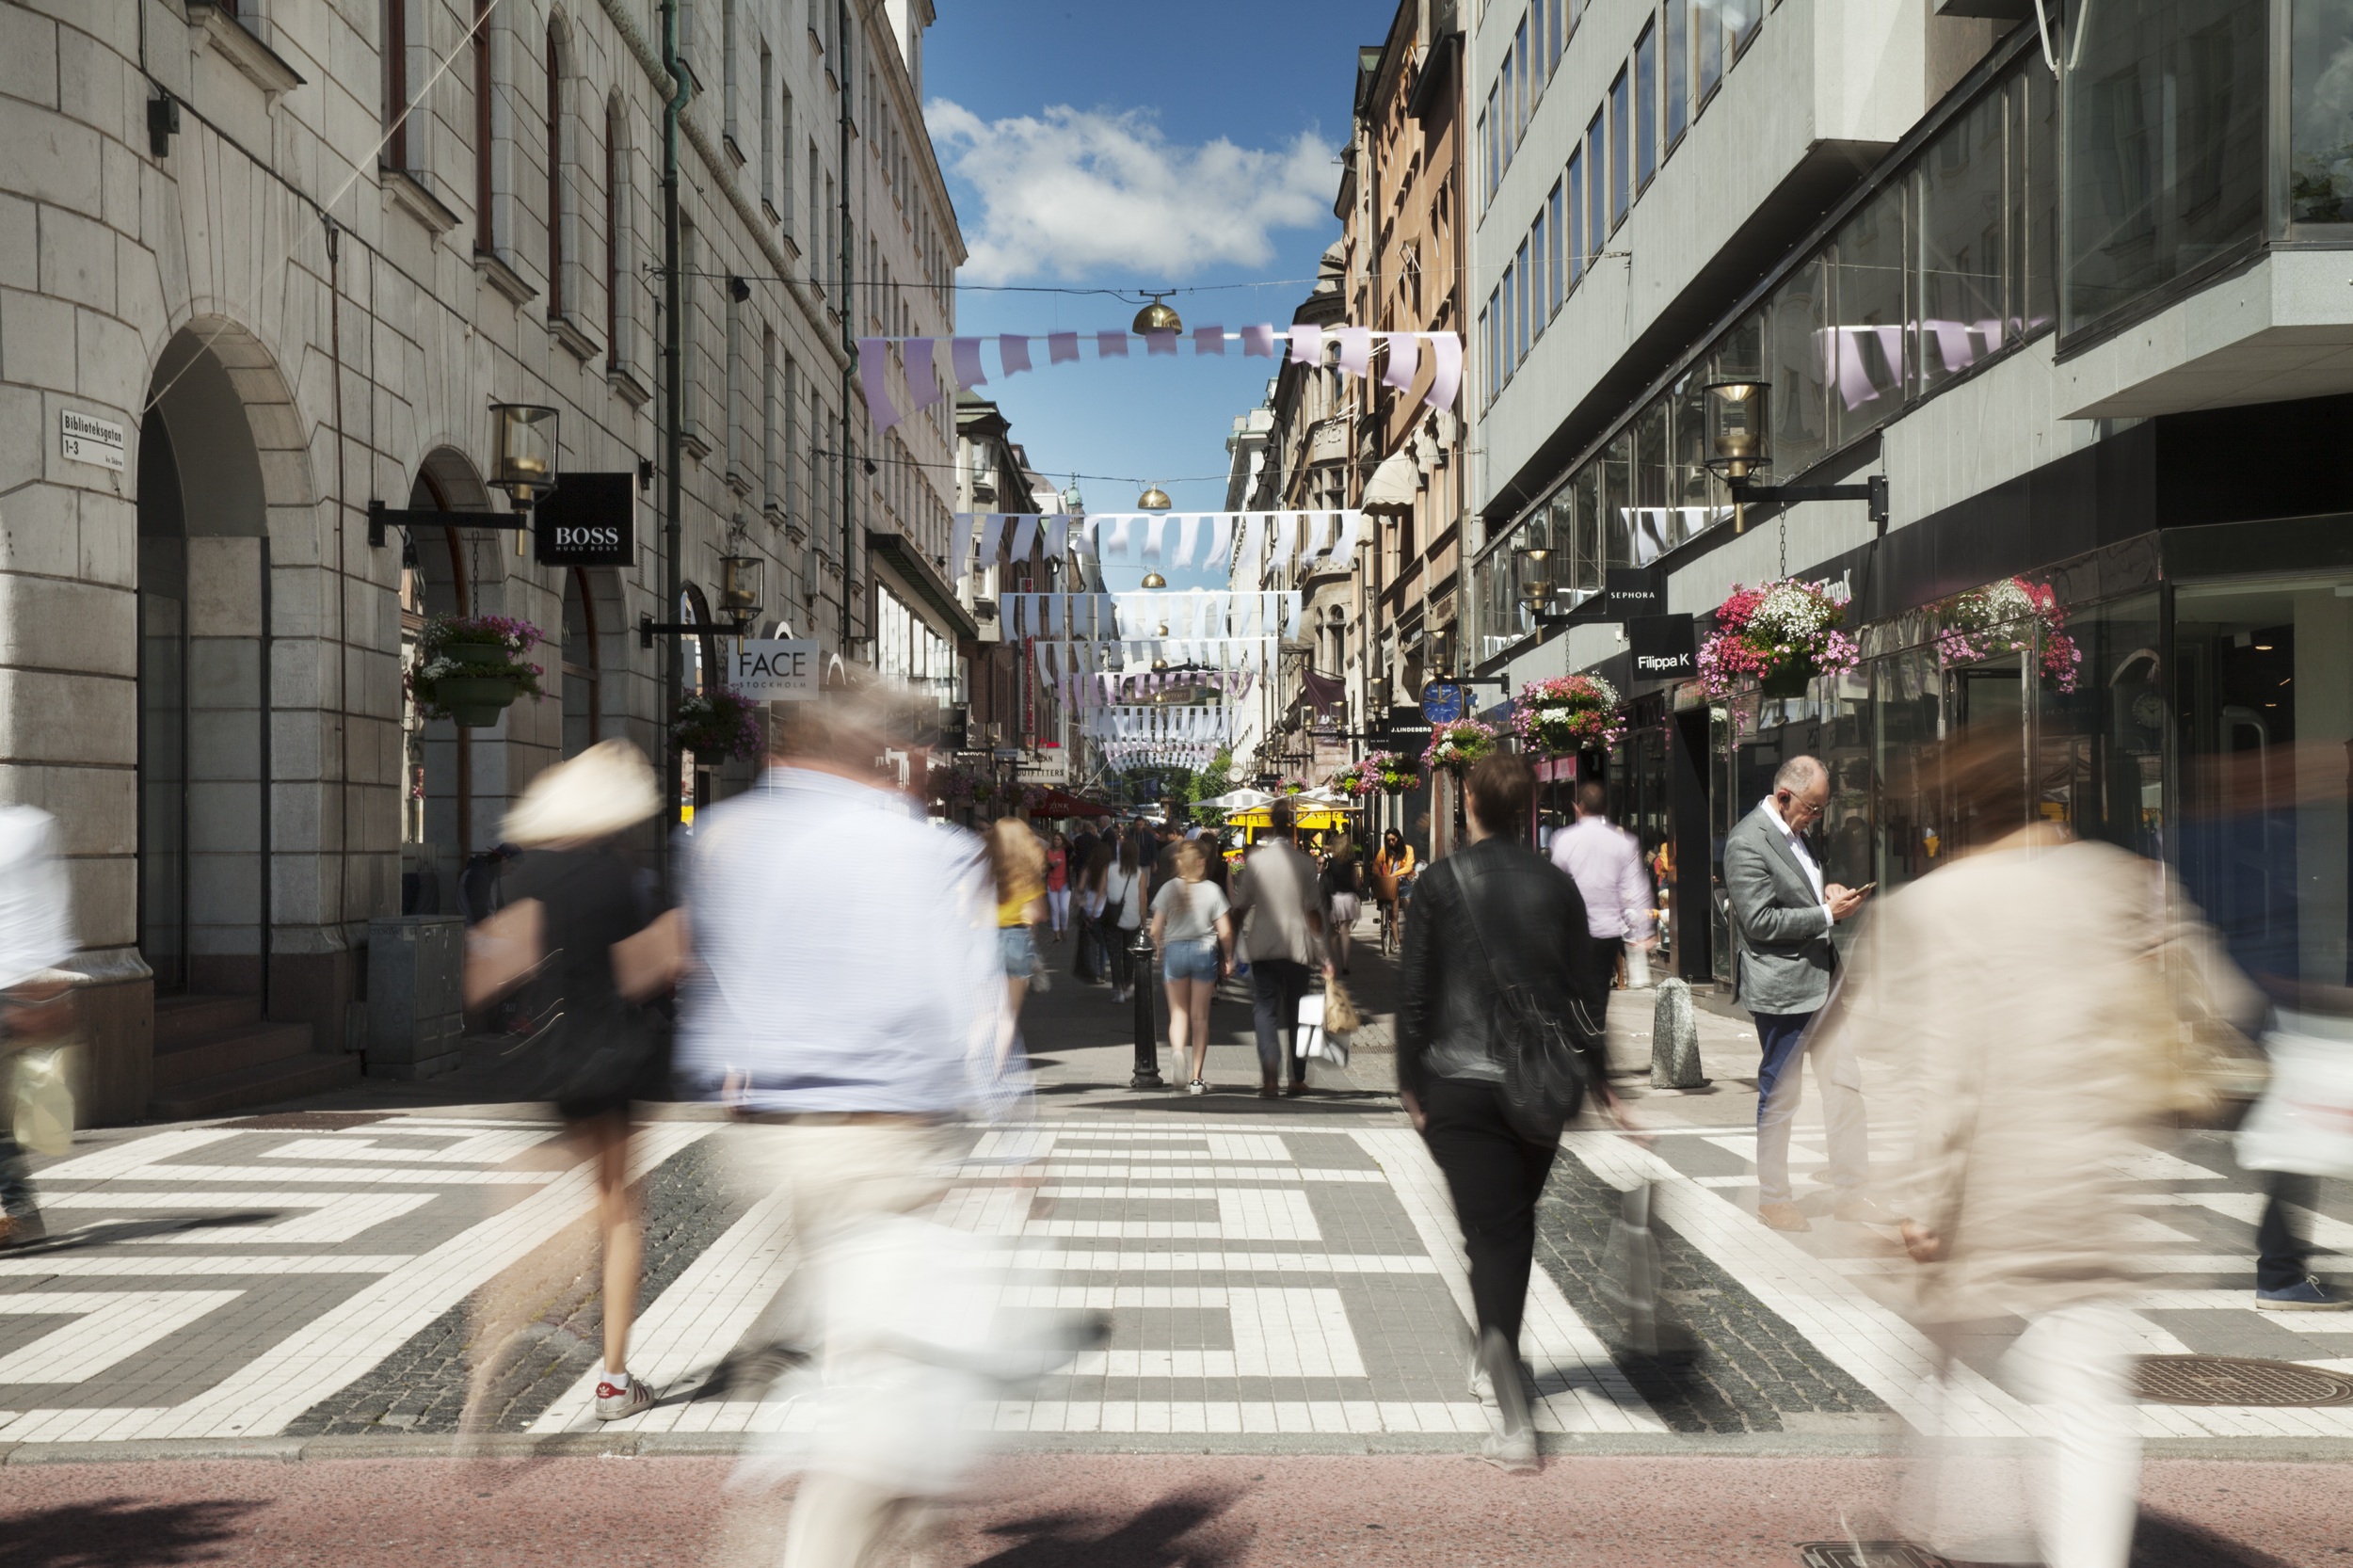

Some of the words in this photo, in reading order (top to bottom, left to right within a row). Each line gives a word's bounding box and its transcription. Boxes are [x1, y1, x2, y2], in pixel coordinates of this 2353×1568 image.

[65, 415, 121, 442] Biblioteksgatan
[65, 440, 79, 455] 1-3
[555, 527, 618, 545] BOSS
[1610, 591, 1656, 600] SEPHORA
[738, 651, 807, 677] FACE
[1638, 656, 1678, 671] Filippa
[1679, 652, 1690, 666] K
[1029, 755, 1053, 763] UAN
